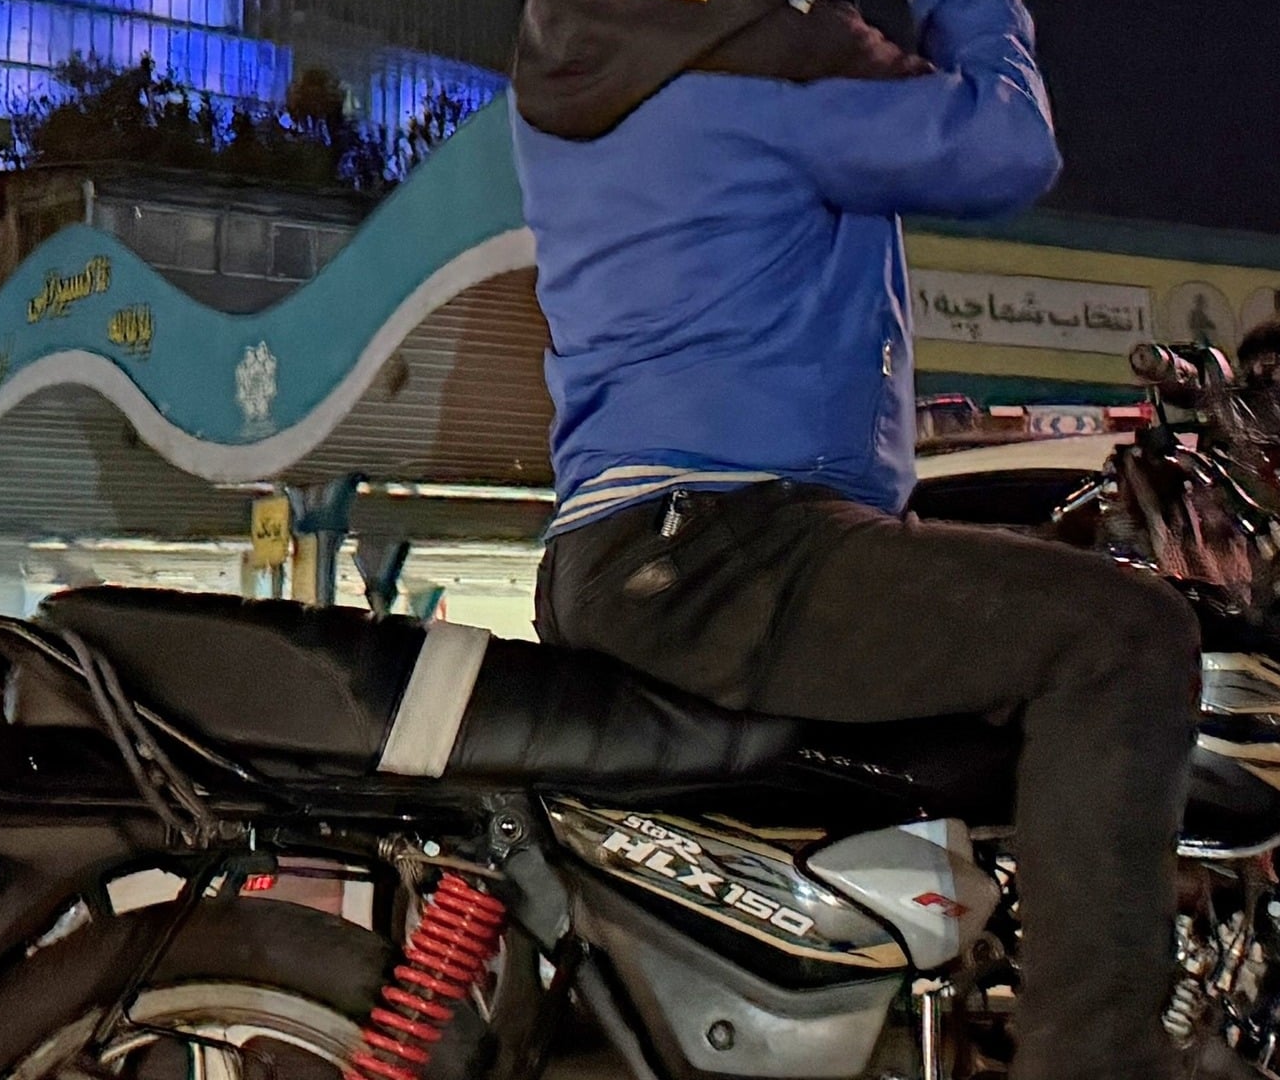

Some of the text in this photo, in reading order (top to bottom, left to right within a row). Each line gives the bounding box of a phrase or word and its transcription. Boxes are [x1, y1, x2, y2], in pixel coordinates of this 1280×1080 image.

[988, 291, 1045, 324] شما
[1047, 301, 1145, 337] انتخاب
[601, 830, 817, 937] HLX 150
